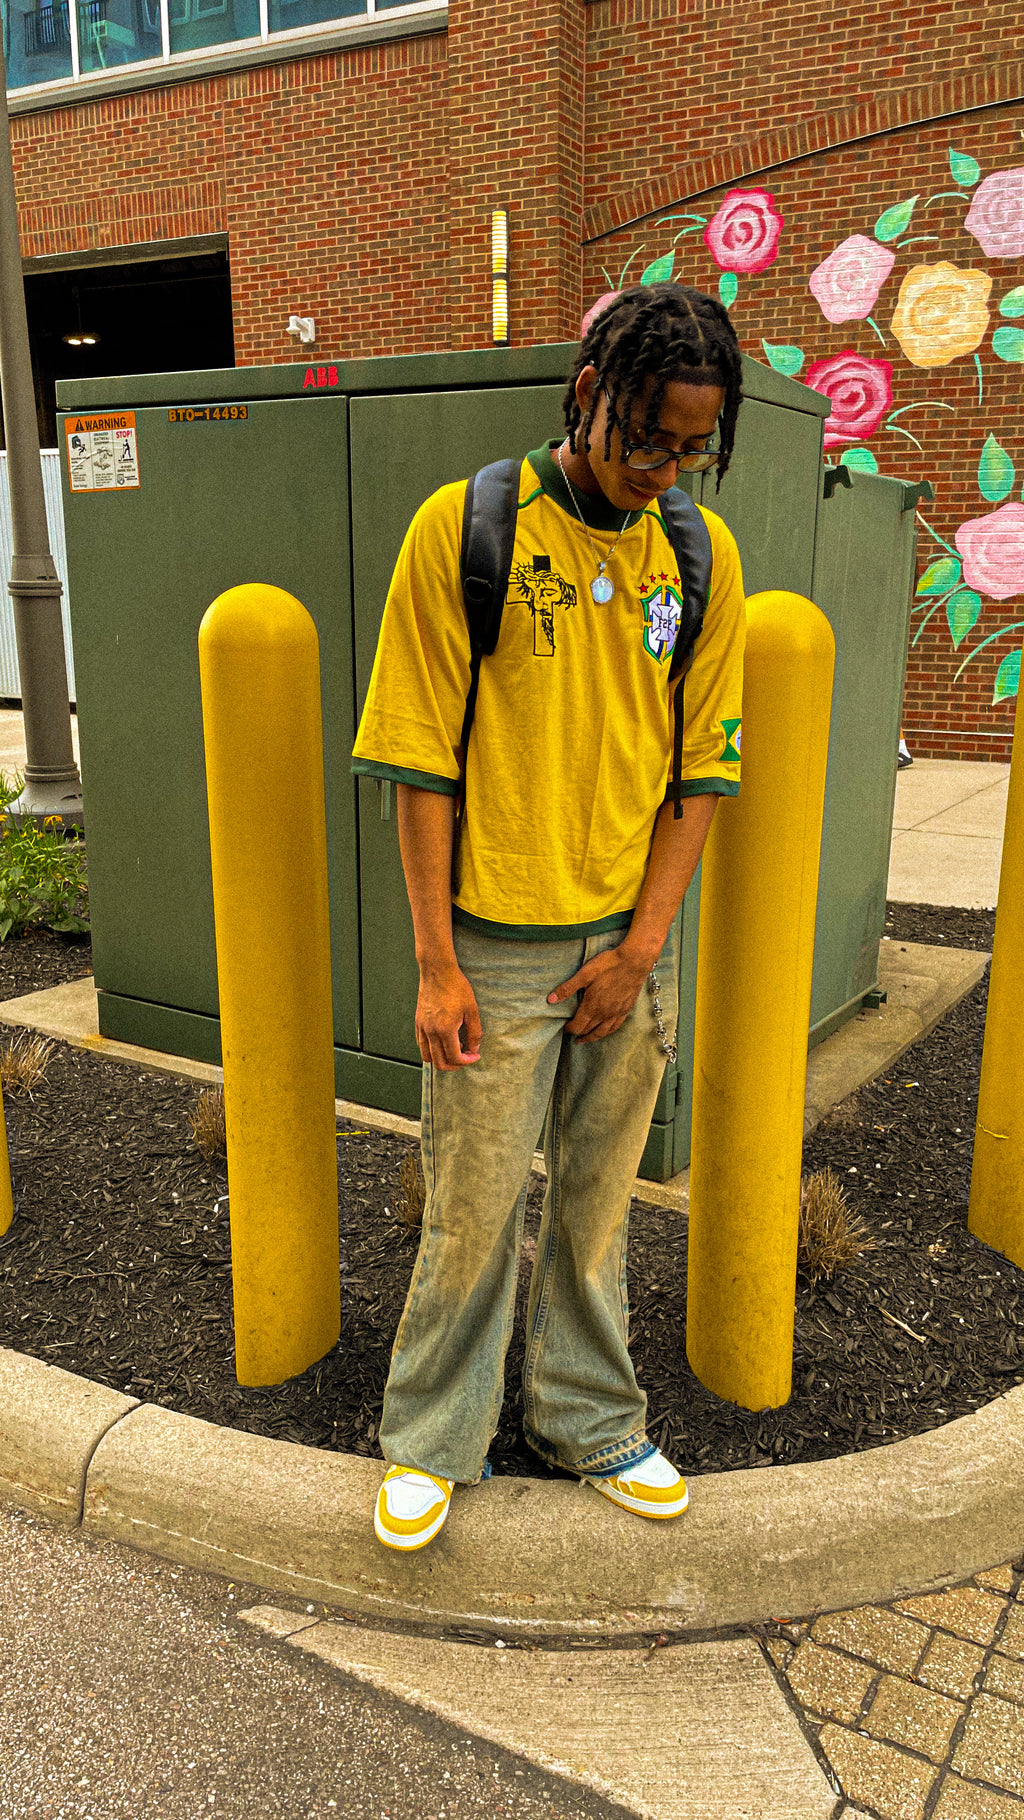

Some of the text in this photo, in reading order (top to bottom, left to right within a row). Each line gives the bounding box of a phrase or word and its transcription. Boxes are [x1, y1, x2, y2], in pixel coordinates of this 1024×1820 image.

[303, 366, 339, 388] ABB
[85, 417, 127, 431] WARNING
[116, 430, 133, 439] STOP!
